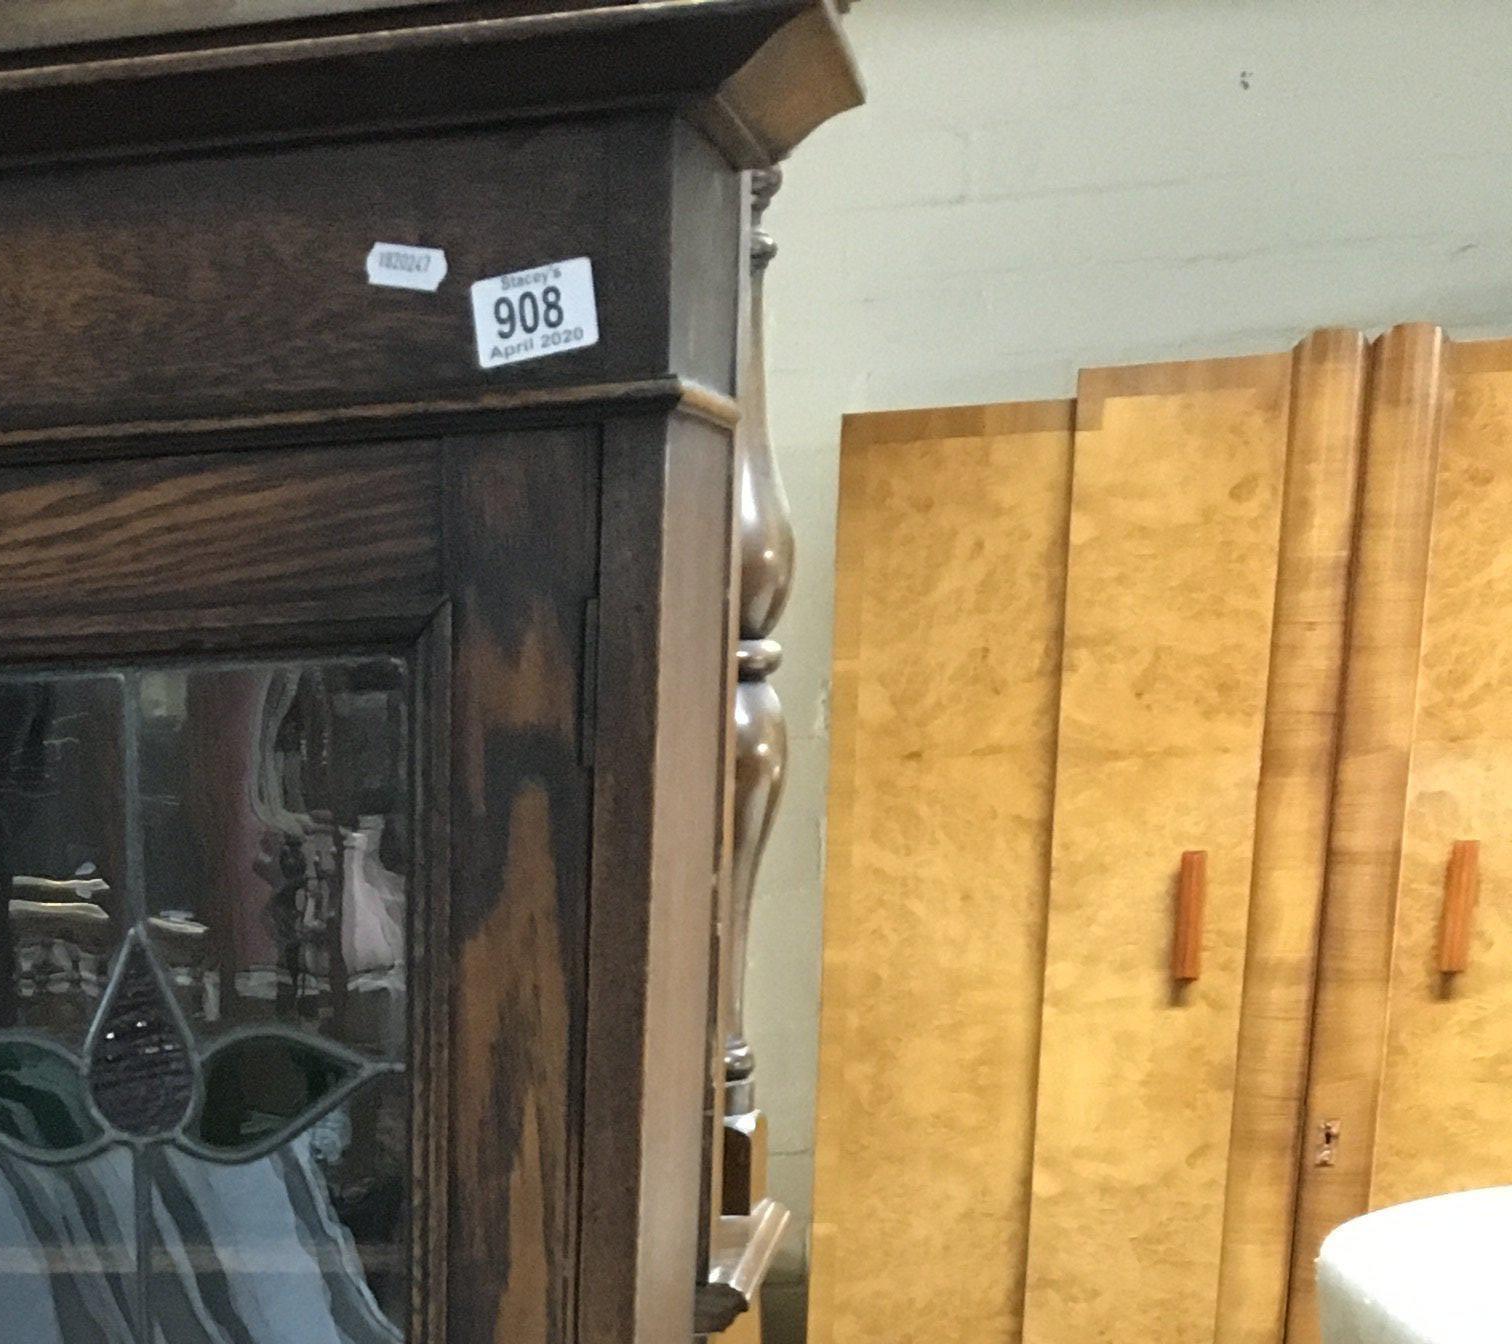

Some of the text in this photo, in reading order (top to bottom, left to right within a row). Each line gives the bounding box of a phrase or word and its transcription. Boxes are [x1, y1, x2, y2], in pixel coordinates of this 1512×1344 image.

[500, 267, 562, 290] Stacey's
[494, 286, 564, 339] 908
[490, 327, 584, 361] April 2020
